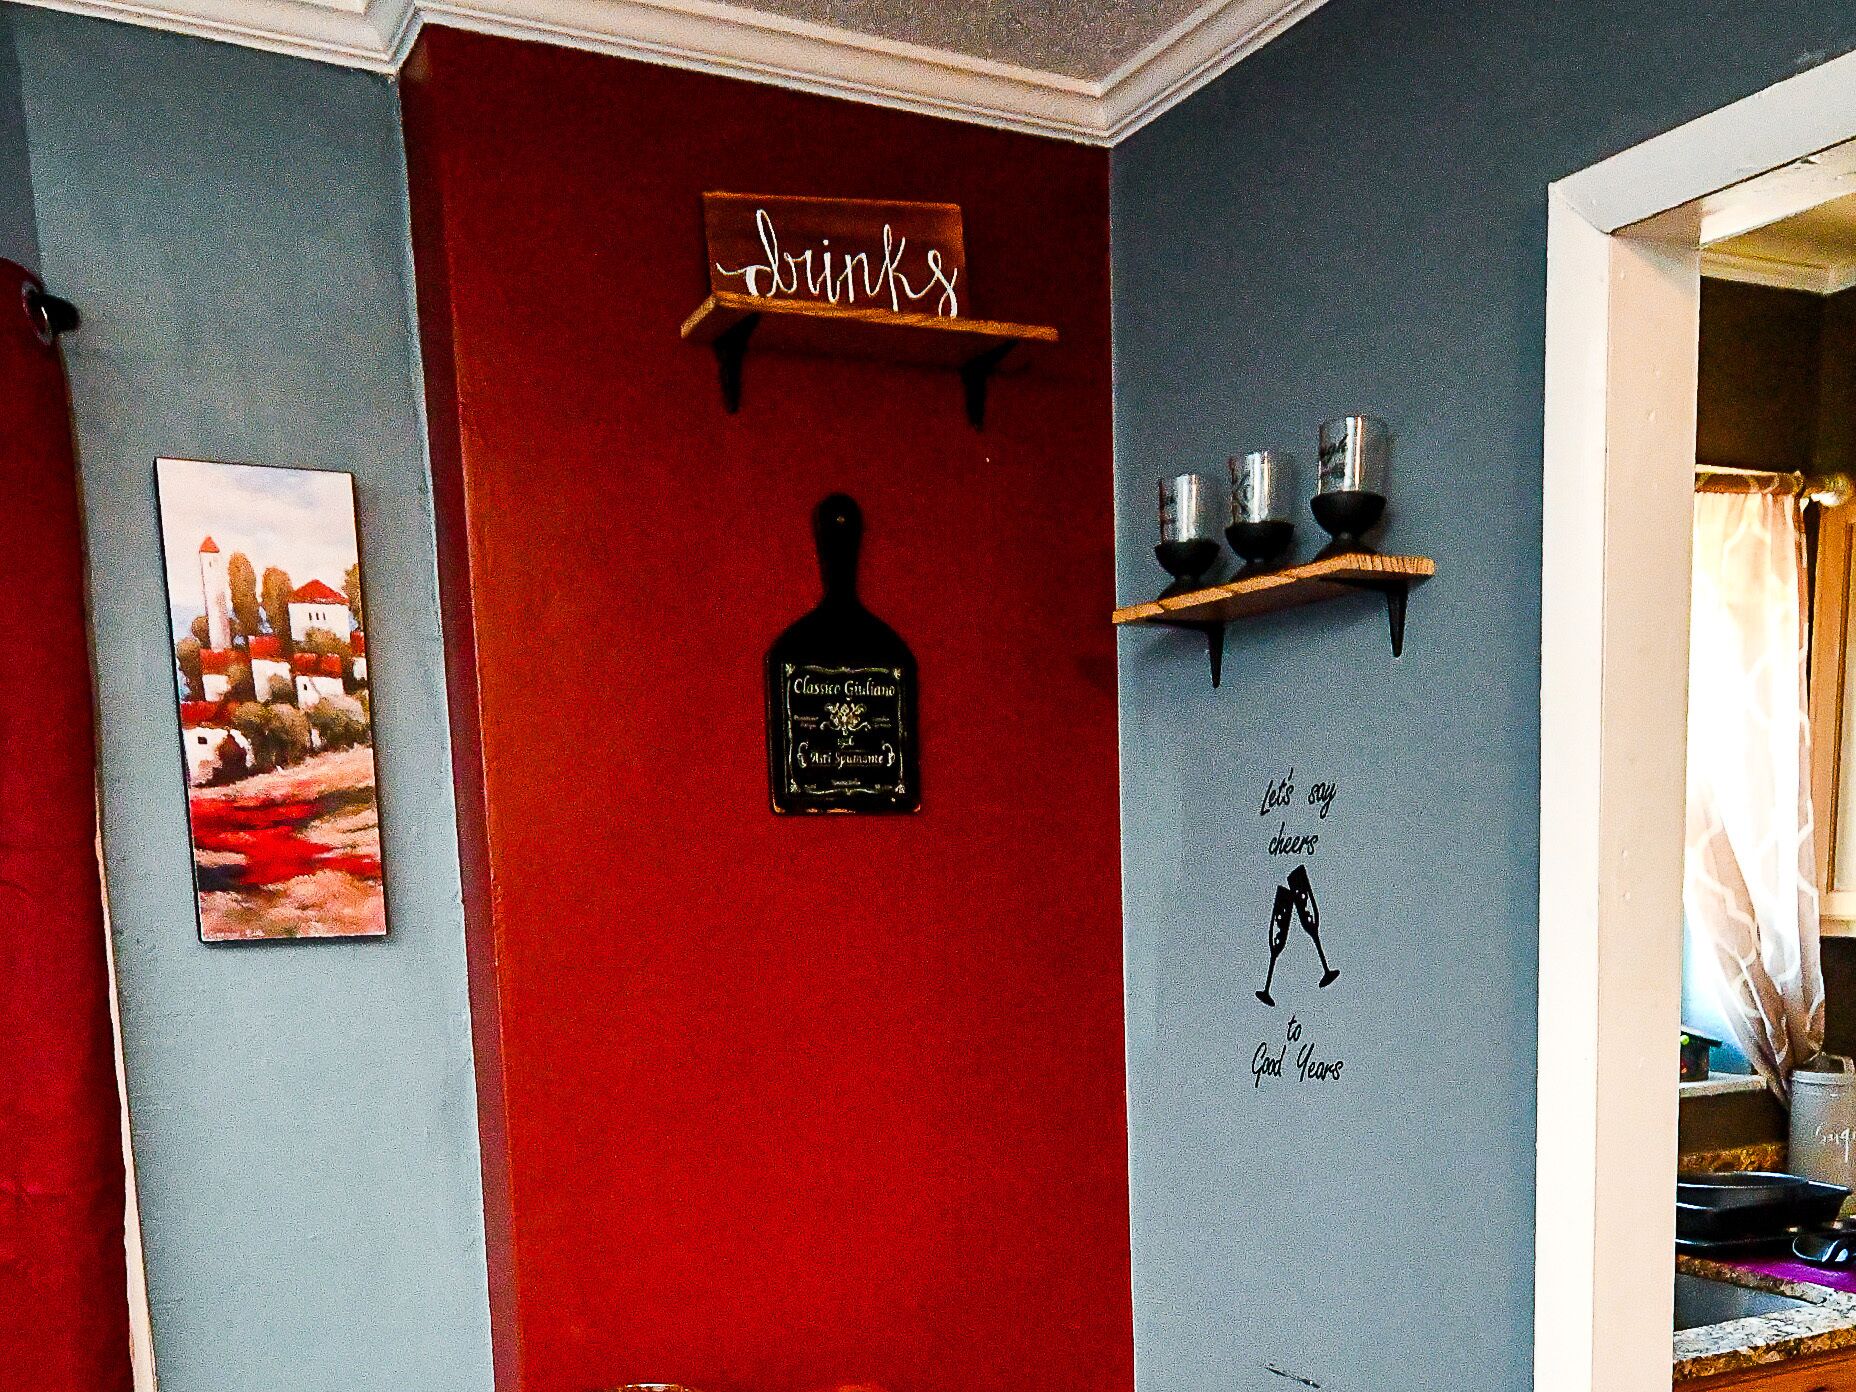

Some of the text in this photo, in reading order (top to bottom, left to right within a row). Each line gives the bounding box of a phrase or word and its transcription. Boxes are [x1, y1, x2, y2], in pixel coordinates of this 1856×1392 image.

[715, 209, 958, 319] drinks
[793, 676, 895, 696] Classico Giuliano
[1260, 768, 1338, 819] Let's say
[1268, 822, 1319, 856] cheers
[1286, 1015, 1302, 1042] to
[1251, 1041, 1344, 1088] Good Years
